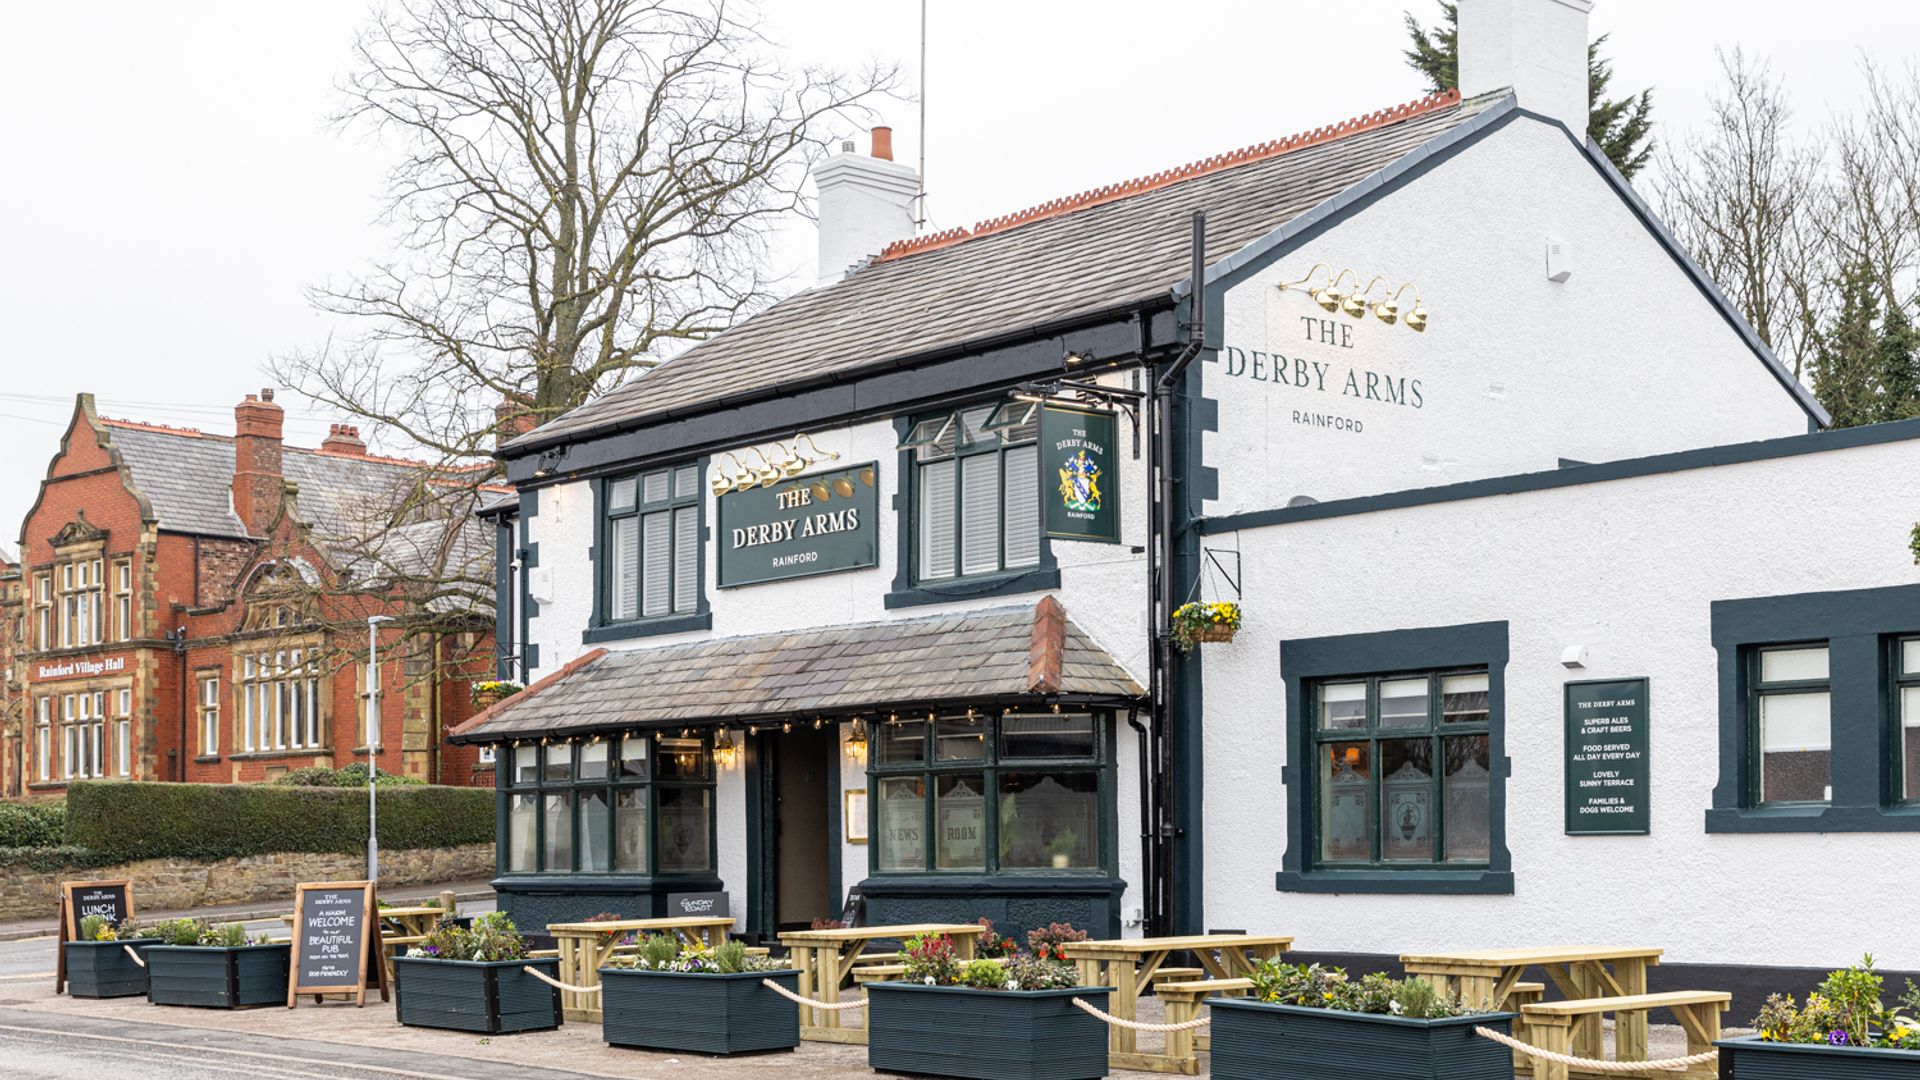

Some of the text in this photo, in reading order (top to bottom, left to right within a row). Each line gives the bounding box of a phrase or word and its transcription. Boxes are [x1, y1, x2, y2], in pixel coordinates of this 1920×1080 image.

[1300, 316, 1354, 348] THE
[1225, 346, 1423, 409] DERBY ARMS
[1292, 410, 1364, 433] RAINFORD
[1072, 428, 1087, 437] THE
[1056, 440, 1104, 455] DERBY ARMS
[776, 488, 812, 510] THE
[1067, 511, 1095, 520] RAINFORD
[732, 508, 858, 549] DERBY ARMS
[772, 552, 818, 567] RAINFORD
[39, 657, 124, 678] Rainford Village Hall
[1577, 699, 1636, 709] THE DERBY ARMS
[1584, 716, 1629, 726] SUPERB ALES
[1587, 726, 1609, 734] CRAFT
[1610, 725, 1632, 733] BEERS
[1583, 743, 1631, 752] FOOD SERVED
[1602, 752, 1625, 760] EVERY
[1593, 770, 1620, 778] LOVELY
[1602, 779, 1635, 787] TERRACE
[1588, 797, 1619, 805] FAMILIES
[1579, 805, 1635, 814] DOGS WELCOME
[889, 826, 977, 841] NEWS ROOM
[680, 898, 714, 907] SUNDAY
[82, 903, 116, 915] LUNCH
[308, 916, 355, 927] WELCOME
[309, 936, 353, 945] BEAUTIFUL
[322, 945, 339, 953] PUB
